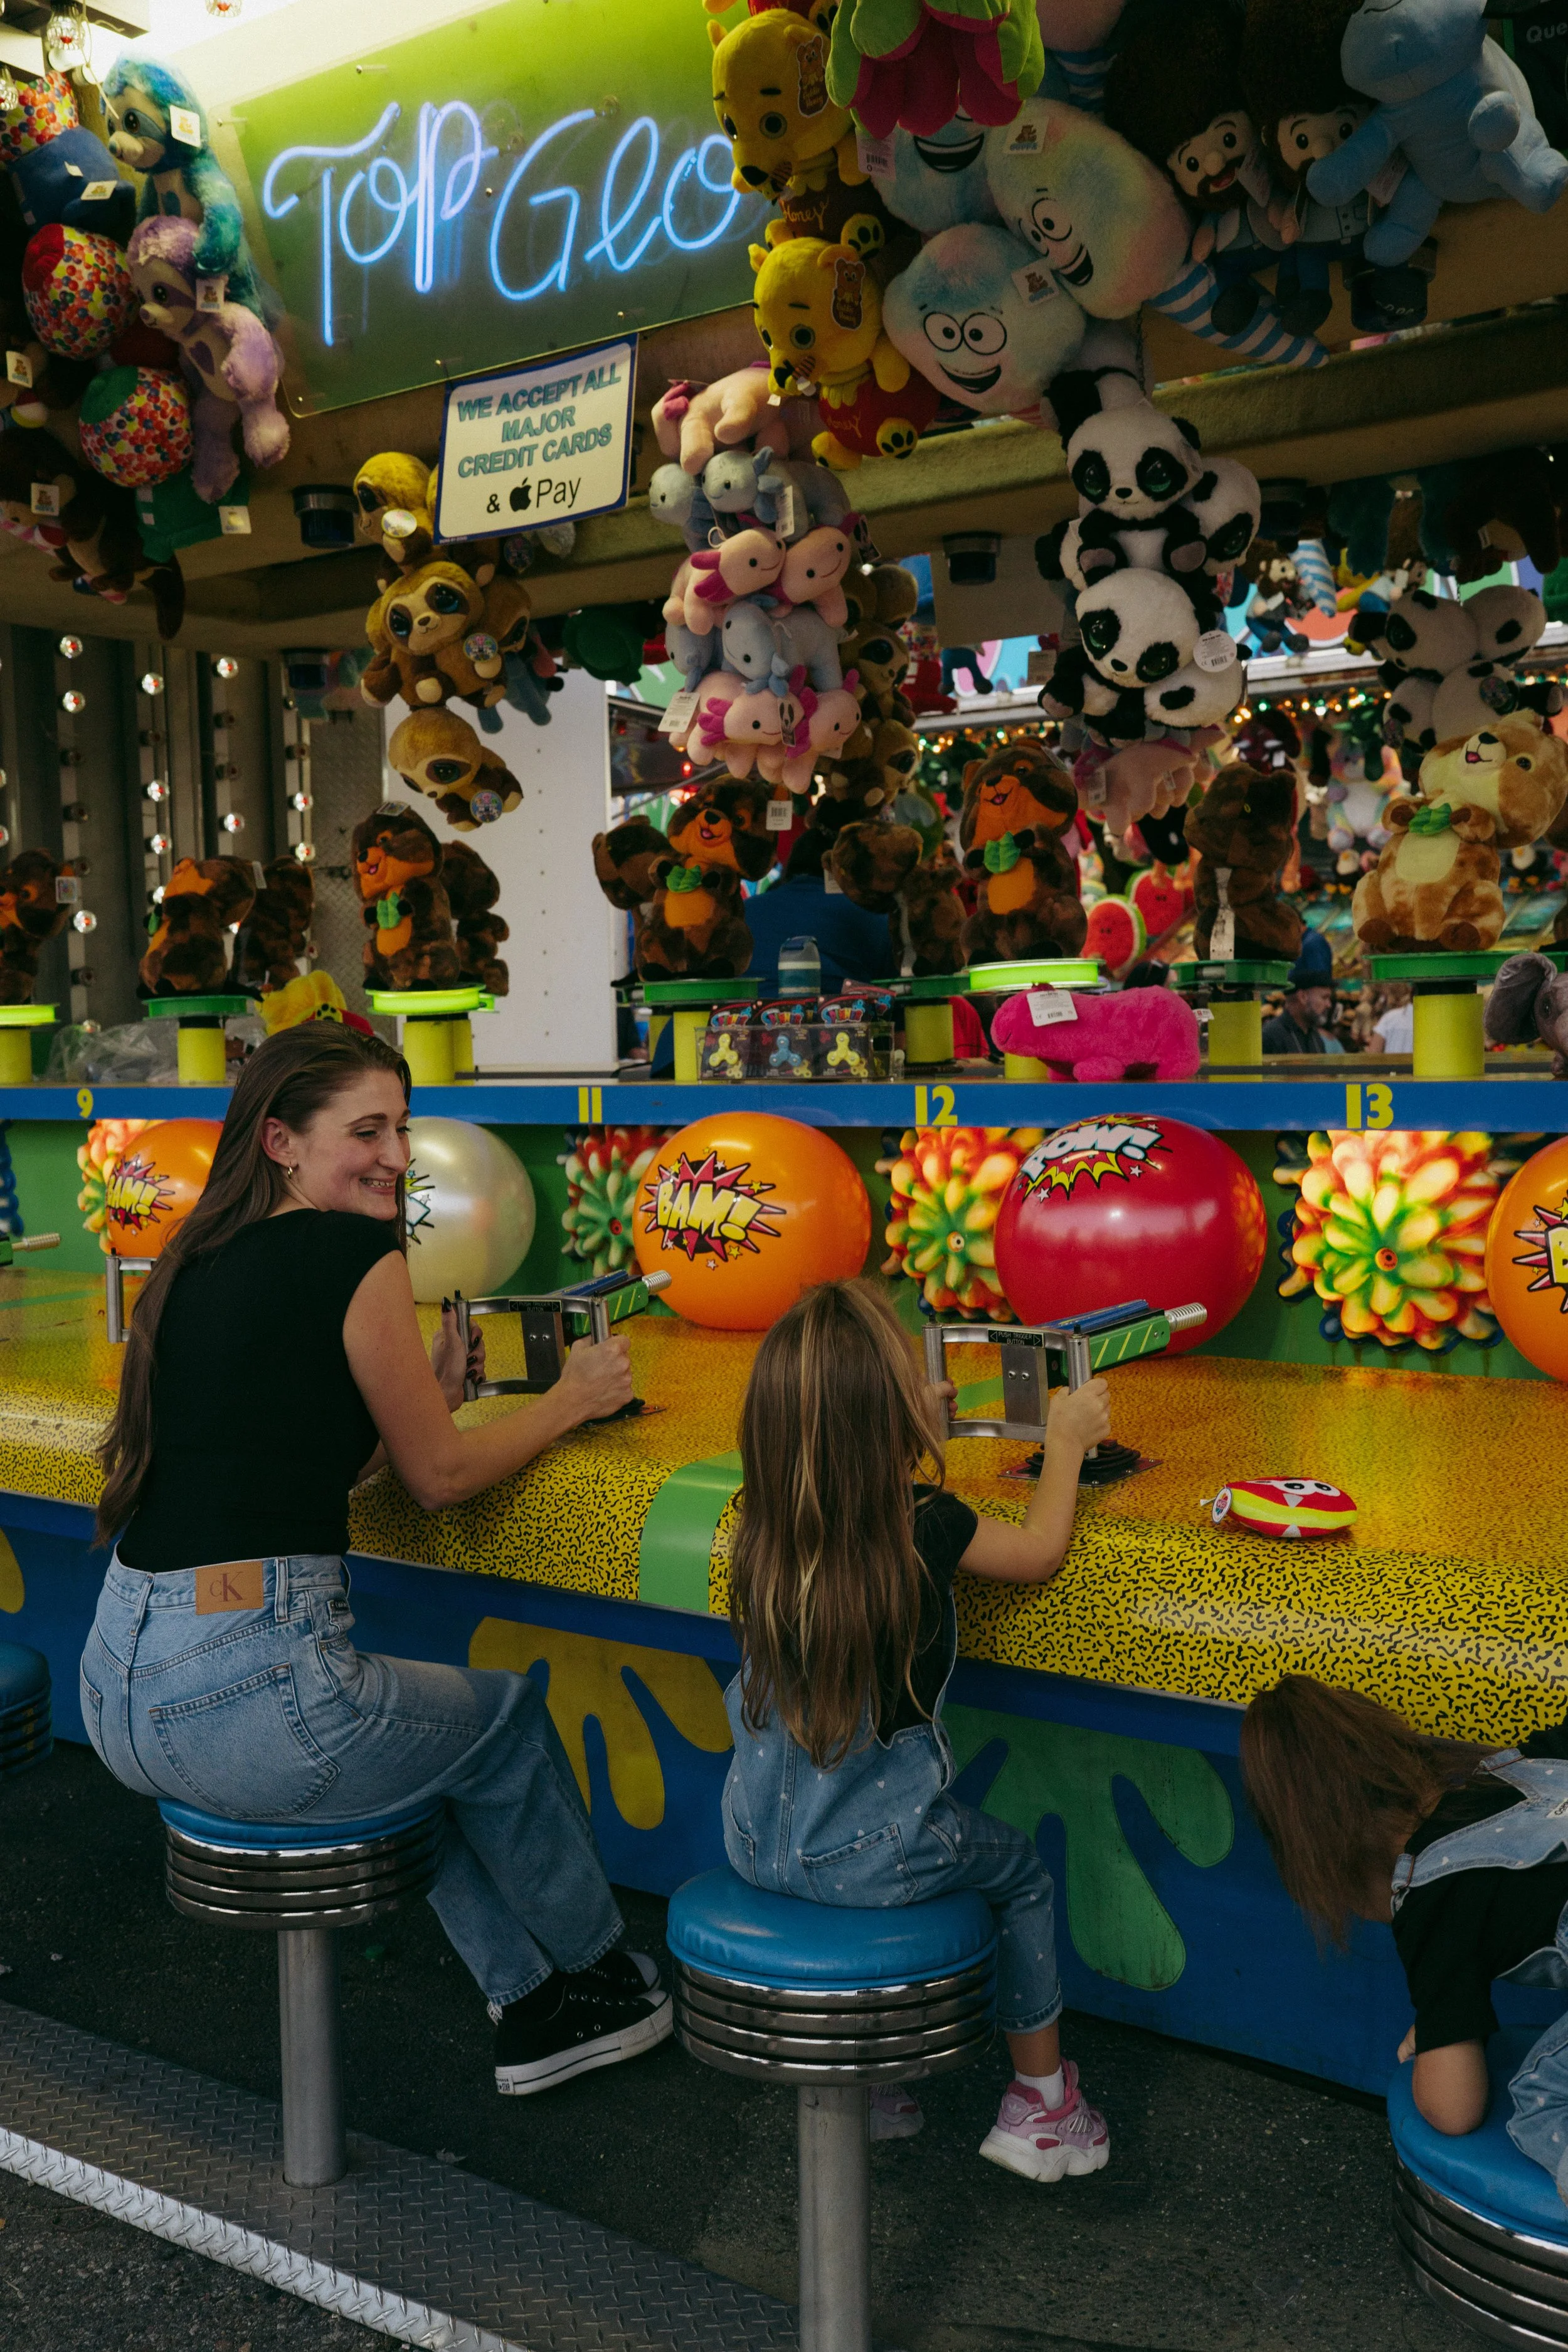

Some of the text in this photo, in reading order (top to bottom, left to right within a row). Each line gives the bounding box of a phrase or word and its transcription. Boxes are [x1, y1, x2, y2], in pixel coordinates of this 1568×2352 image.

[457, 363, 622, 422] WE ACCEPT ALL
[501, 405, 576, 443] MAJOR
[458, 423, 613, 478] CREDIT CARDS
[487, 478, 581, 513] & Pay
[77, 1088, 93, 1119] 9
[578, 1087, 602, 1123] 11
[915, 1085, 958, 1126] 12
[1346, 1083, 1394, 1129] 13
[1020, 1123, 1163, 1183] POW!
[657, 1180, 763, 1242] BAM!
